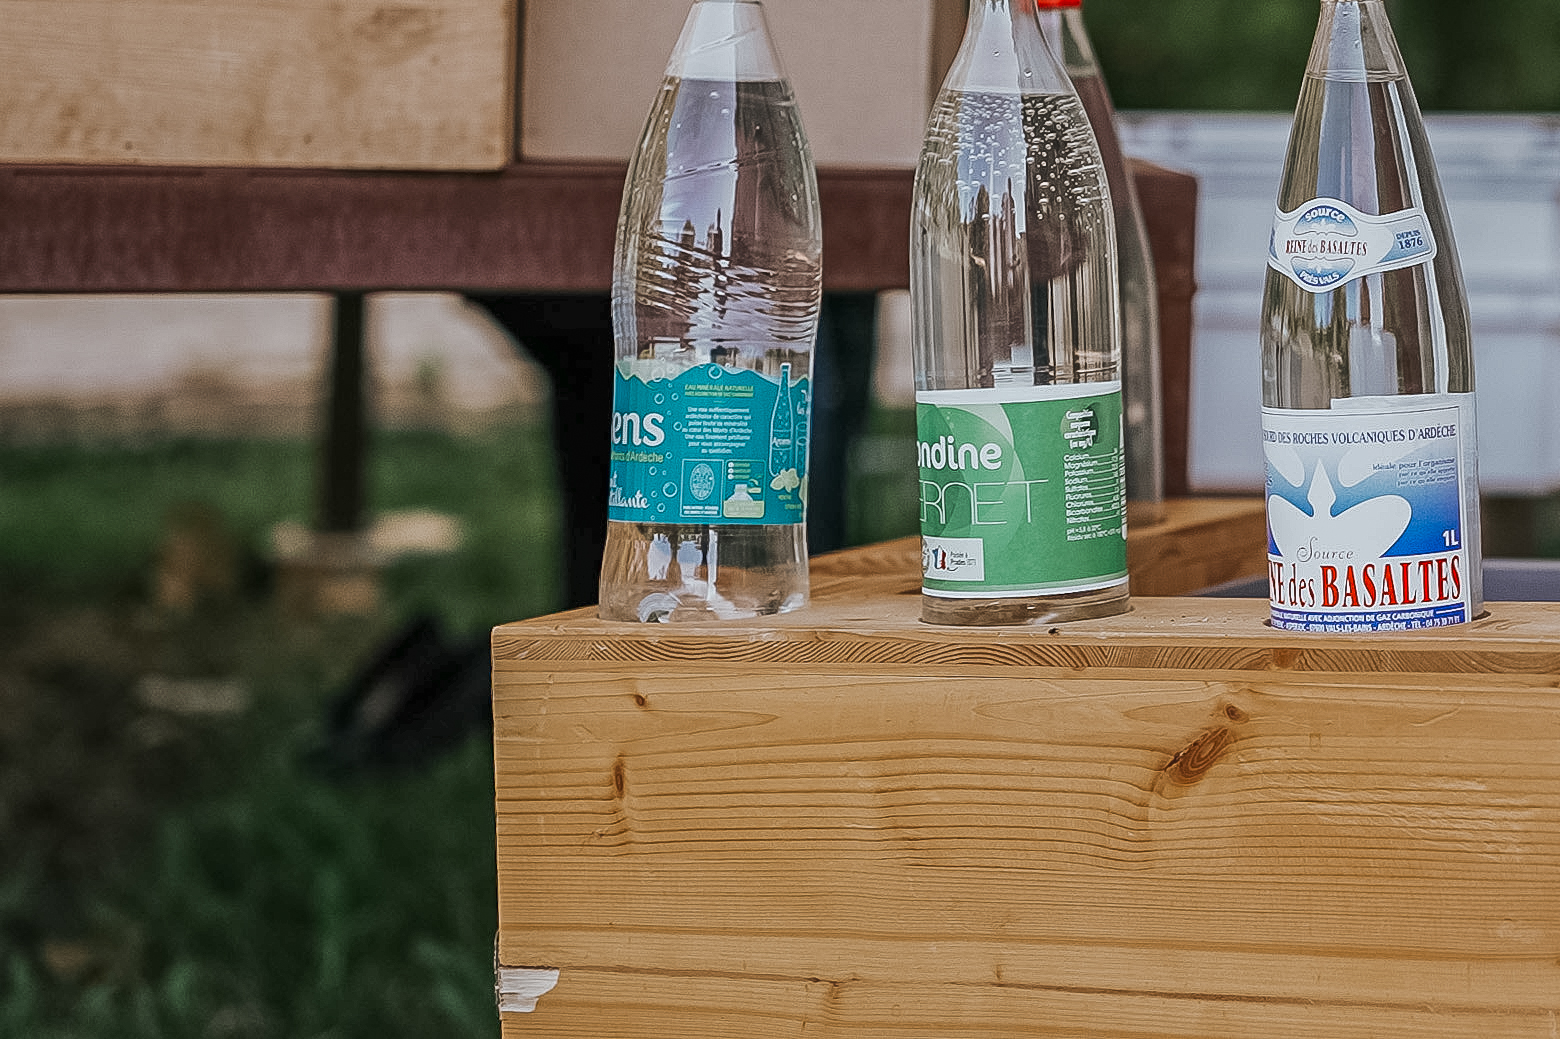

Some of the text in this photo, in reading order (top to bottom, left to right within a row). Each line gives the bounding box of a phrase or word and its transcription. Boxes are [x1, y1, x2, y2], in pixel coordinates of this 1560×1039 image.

[1305, 207, 1345, 222] source
[1319, 239, 1368, 257] BASALTES
[1399, 239, 1424, 250] 1876
[1292, 432, 1330, 445] ROCHES
[1331, 428, 1406, 445] VOLCANIQUES
[1442, 529, 1460, 548] 1L
[1296, 535, 1355, 562] Source
[1288, 563, 1316, 608] des
[1319, 554, 1462, 609] BASALTES
[1376, 612, 1392, 622] GAZ
